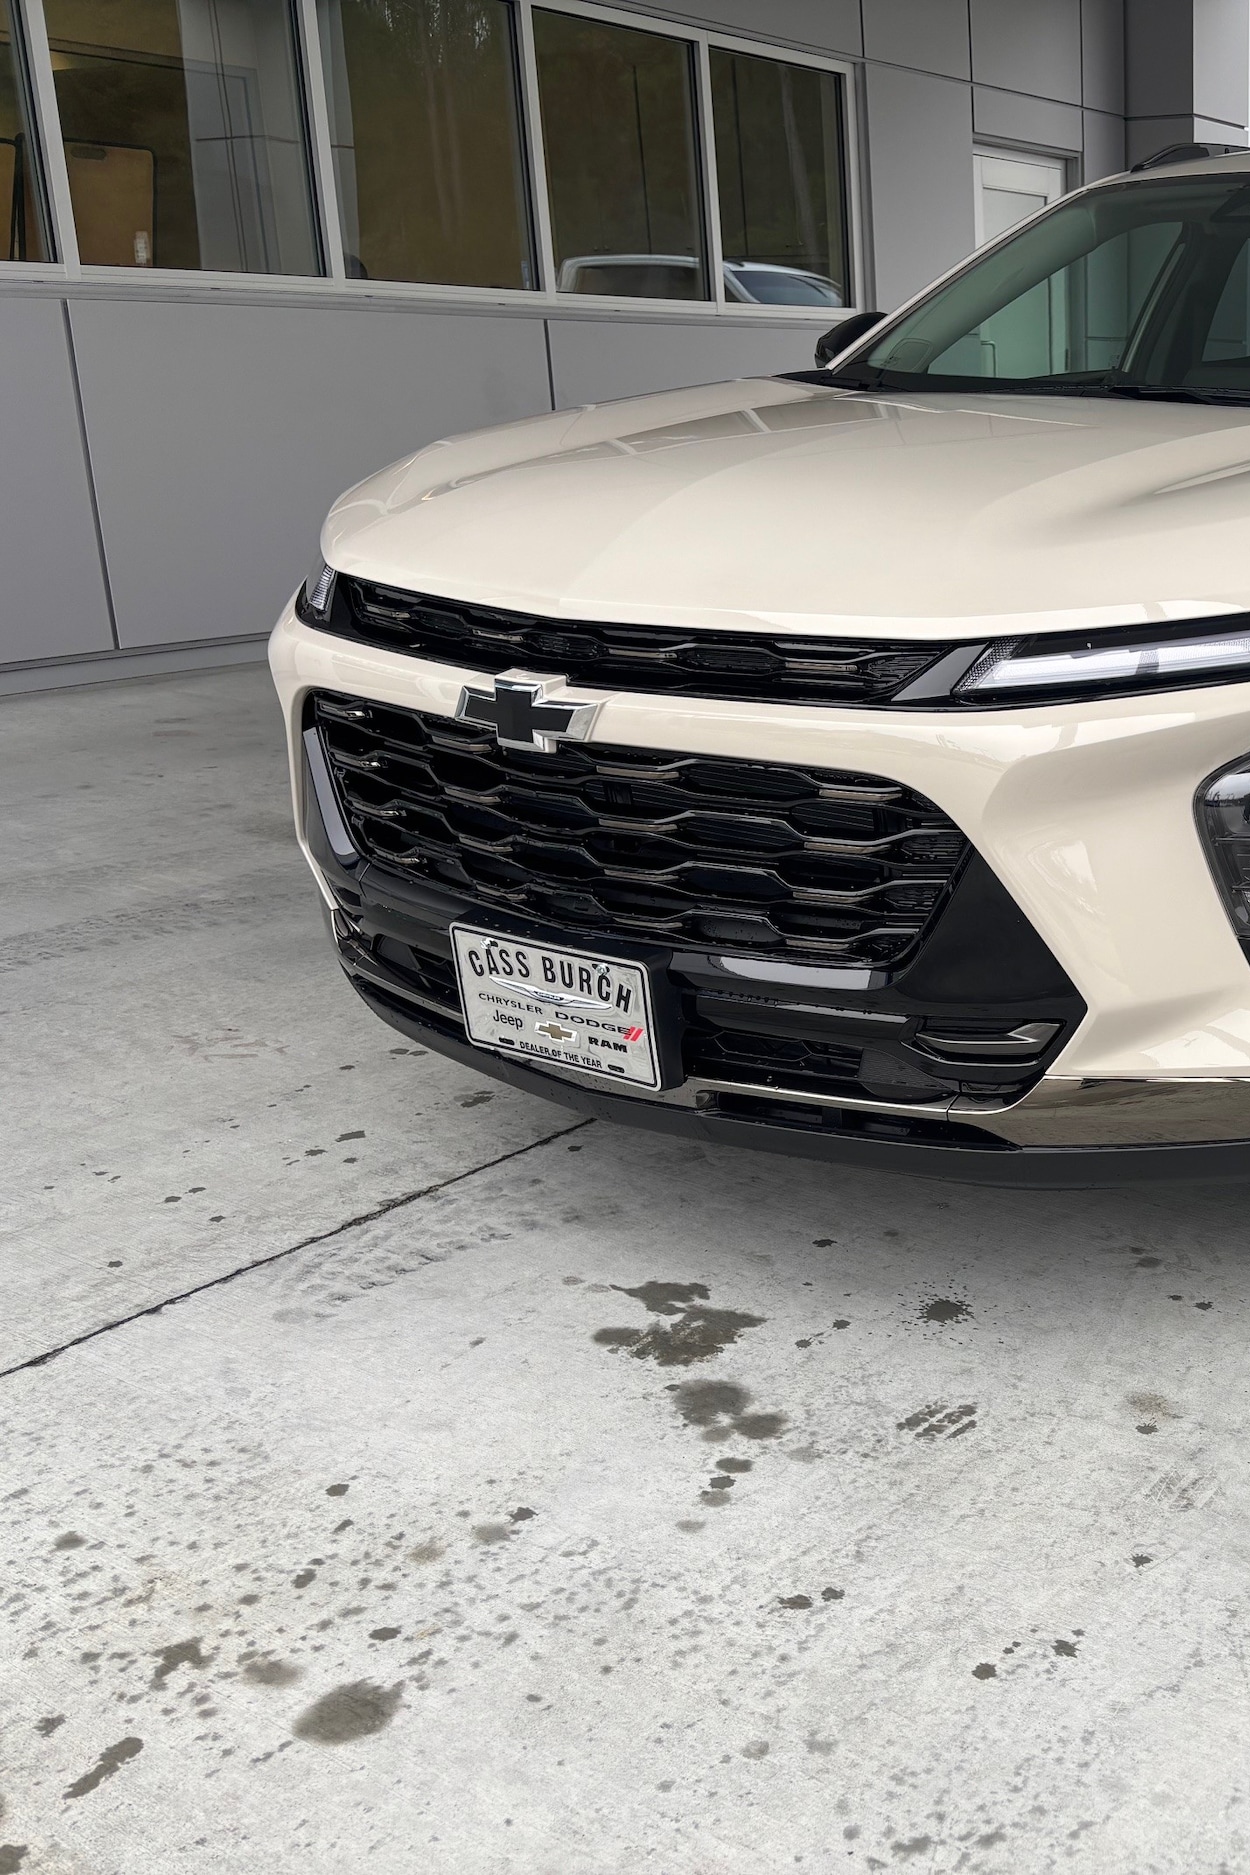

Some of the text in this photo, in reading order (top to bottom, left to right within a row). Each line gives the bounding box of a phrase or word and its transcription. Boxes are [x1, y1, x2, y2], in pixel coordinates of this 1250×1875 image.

[468, 949, 632, 1013] CASS BURCH
[478, 993, 543, 1015] CHRYSLER
[555, 1011, 632, 1036] DODGE
[493, 1009, 523, 1030] Jeep
[519, 1041, 602, 1069] DEALER OF THE YEAR
[588, 1036, 628, 1053] RAM
